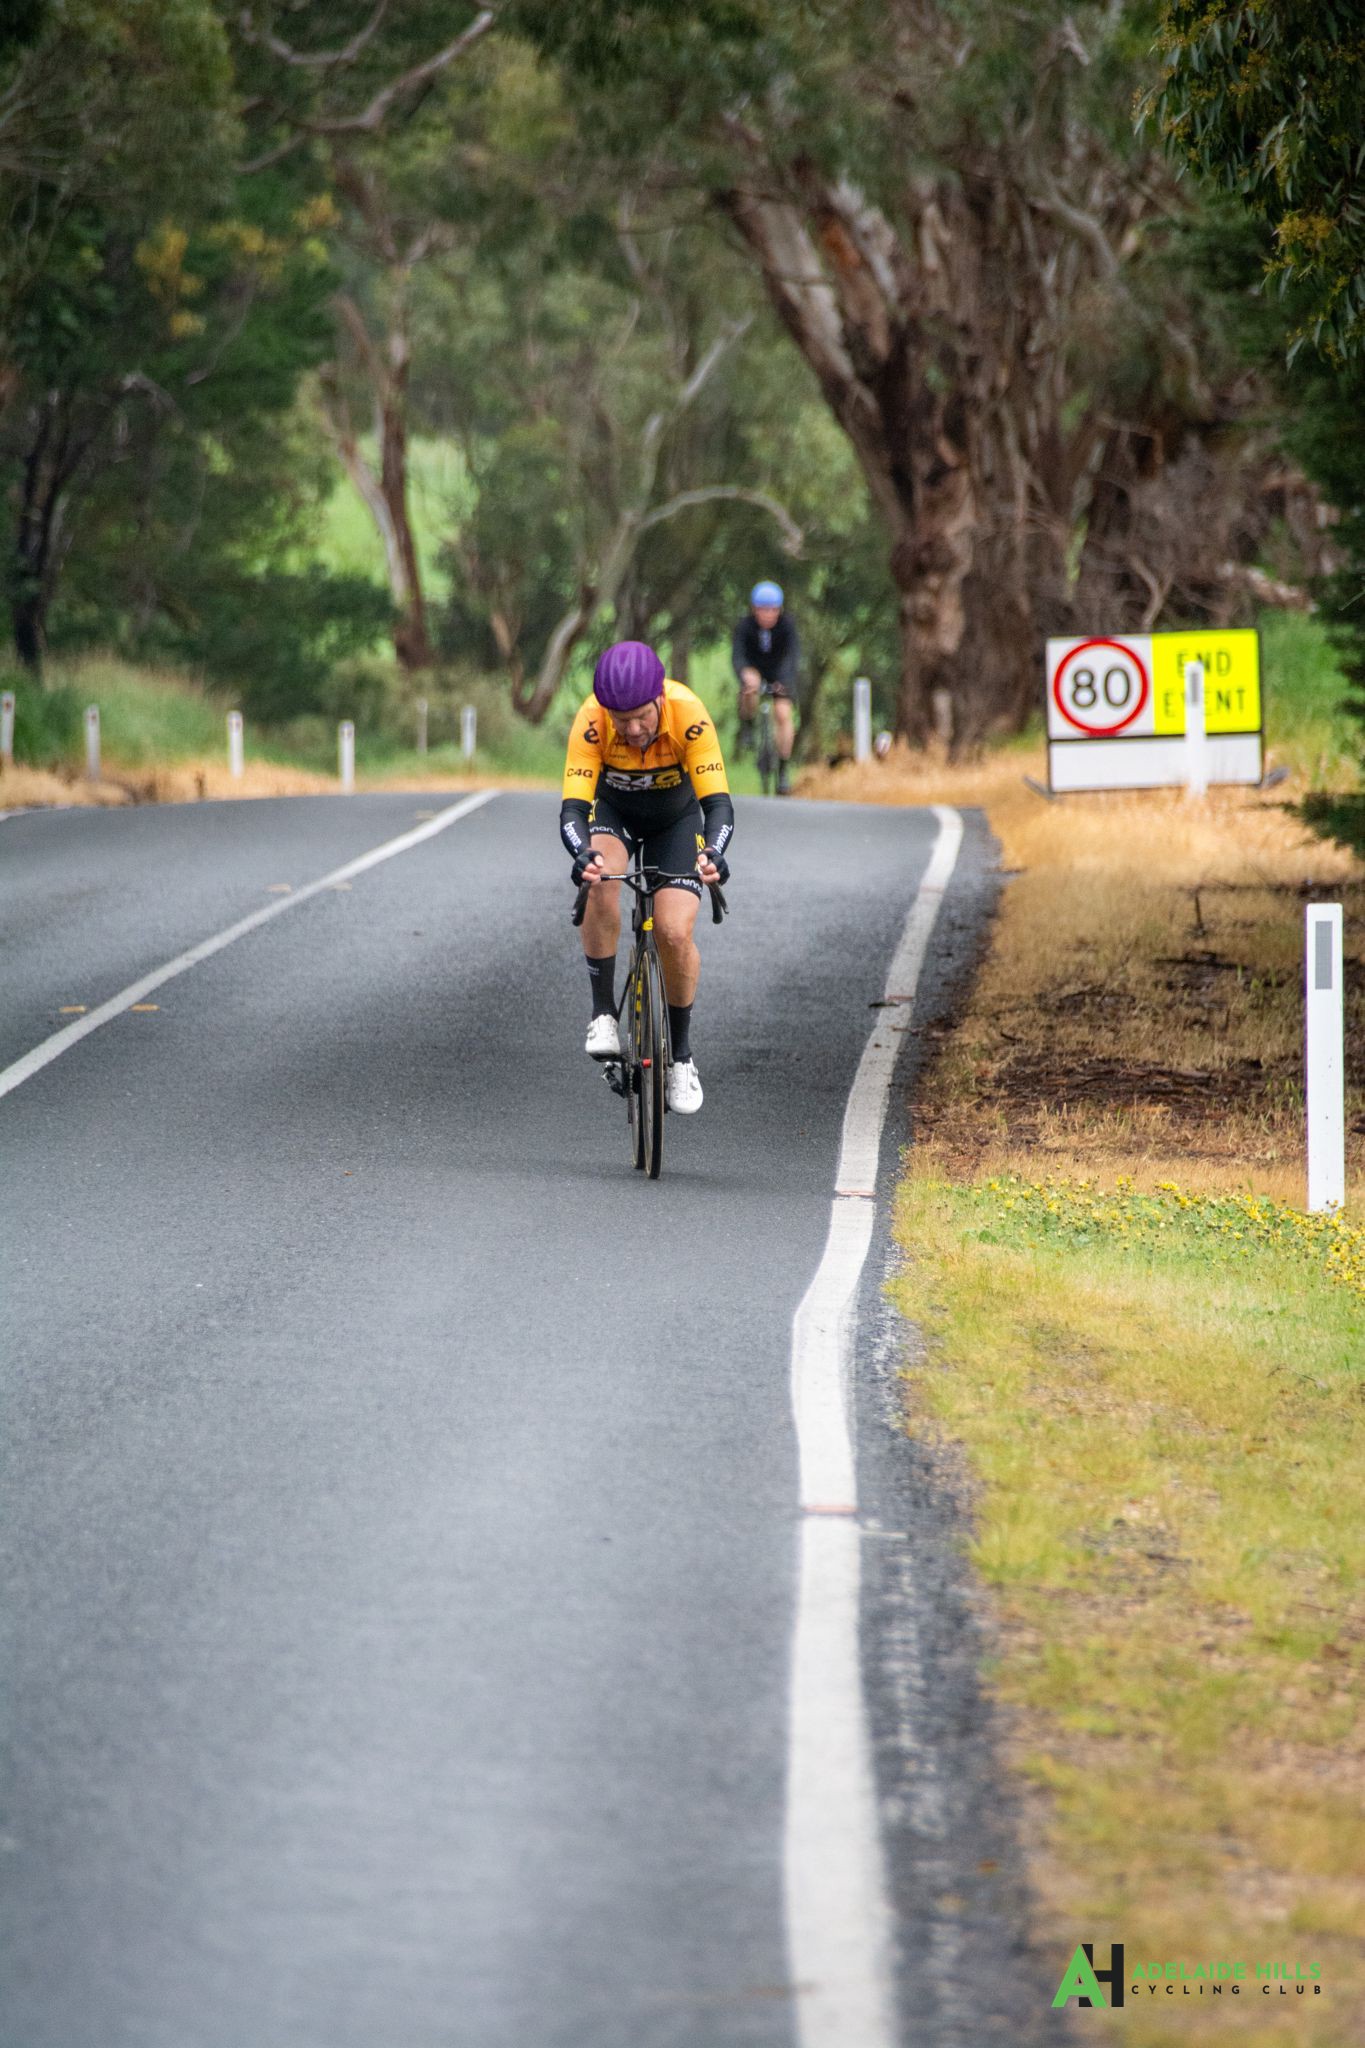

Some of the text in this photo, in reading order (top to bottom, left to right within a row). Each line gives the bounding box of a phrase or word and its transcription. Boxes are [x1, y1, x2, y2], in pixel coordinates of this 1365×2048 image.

[1072, 668, 1131, 708] 80
[1163, 688, 1246, 718] ENT
[567, 768, 593, 778] C4G
[696, 763, 722, 775] C4G
